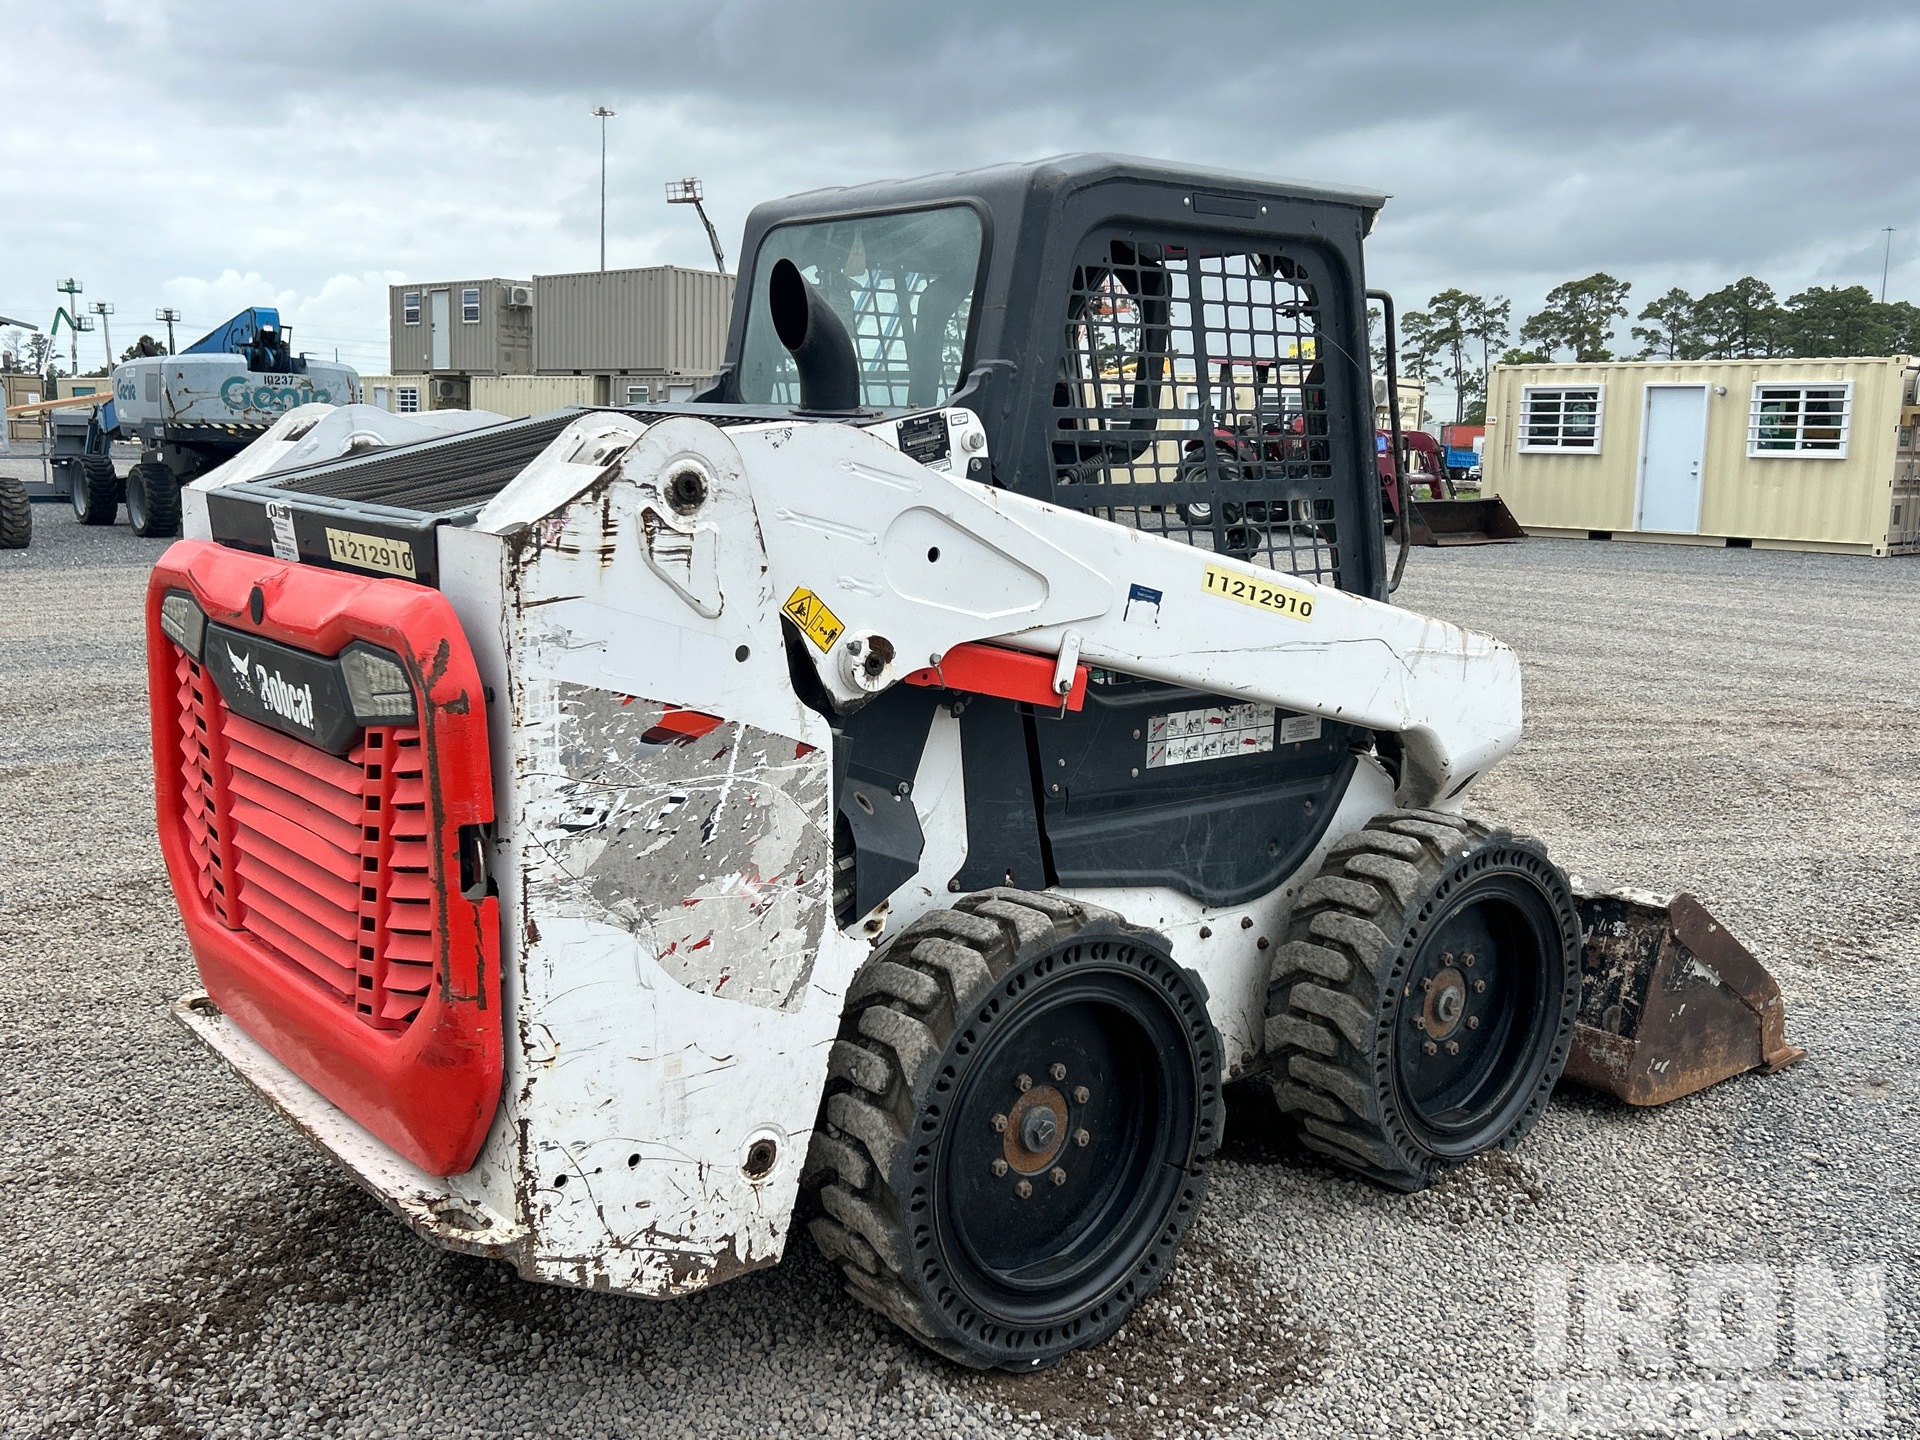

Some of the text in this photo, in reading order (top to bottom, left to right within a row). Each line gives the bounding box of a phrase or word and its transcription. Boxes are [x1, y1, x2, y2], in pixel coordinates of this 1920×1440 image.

[263, 375, 294, 386] 10237
[328, 537, 414, 571] 11212910
[1206, 571, 1312, 617] 11212910
[255, 663, 315, 730] Bobcat
